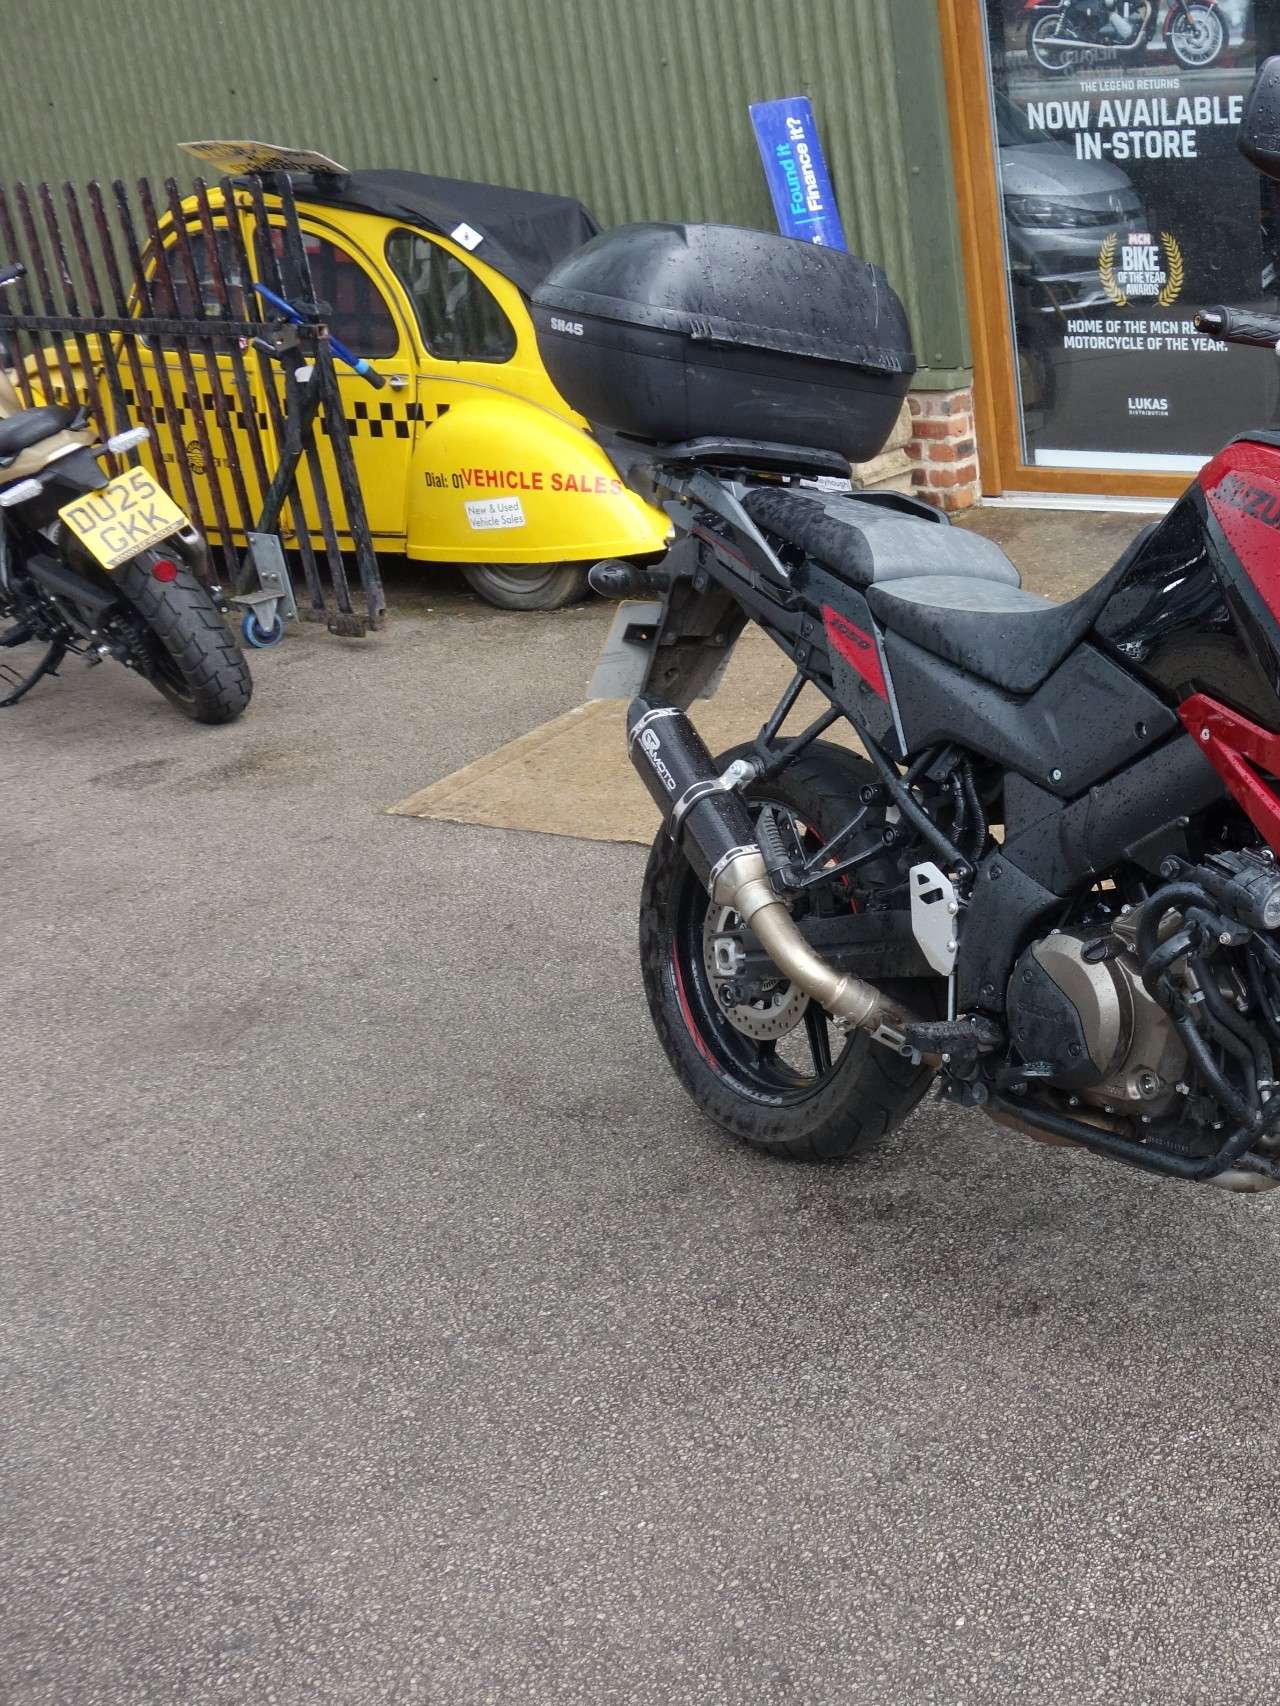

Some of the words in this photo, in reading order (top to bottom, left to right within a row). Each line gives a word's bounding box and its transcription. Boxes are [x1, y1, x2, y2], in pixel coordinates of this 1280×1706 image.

[1080, 81, 1098, 93] THE
[1099, 80, 1135, 92] LEGEND
[1136, 78, 1181, 91] RETURNS
[1027, 101, 1090, 130] NOW
[1098, 95, 1244, 128] AVAILABLE
[786, 116, 806, 141] it?
[776, 142, 793, 157] it
[1075, 129, 1198, 160] IN-STORE
[780, 158, 807, 215] Found
[796, 142, 824, 213] Finance
[1122, 246, 1160, 271] BIKE
[1118, 271, 1128, 283] OF
[1129, 271, 1144, 283] THE
[1144, 271, 1166, 284] YEAR
[1126, 283, 1159, 296] AWARDS
[1067, 320, 1103, 333] HOME
[1106, 320, 1121, 333] OF
[1123, 320, 1147, 334] THE
[1150, 320, 1179, 334] MCN
[1064, 336, 1144, 350] MOTORCYCLE
[1147, 337, 1163, 350] OF
[1165, 338, 1189, 351] THE
[1191, 338, 1229, 352] YEAR.
[1128, 397, 1168, 410] LUKAS
[425, 471, 449, 489] Dial:
[461, 468, 544, 491] VEHICLE
[551, 473, 623, 496] SALES
[66, 471, 156, 534] DU25
[468, 505, 486, 515] New
[489, 503, 496, 514] &
[497, 499, 519, 513] Used
[100, 502, 170, 553] GKK
[472, 515, 500, 527] Vehicle
[501, 513, 524, 525] Sales
